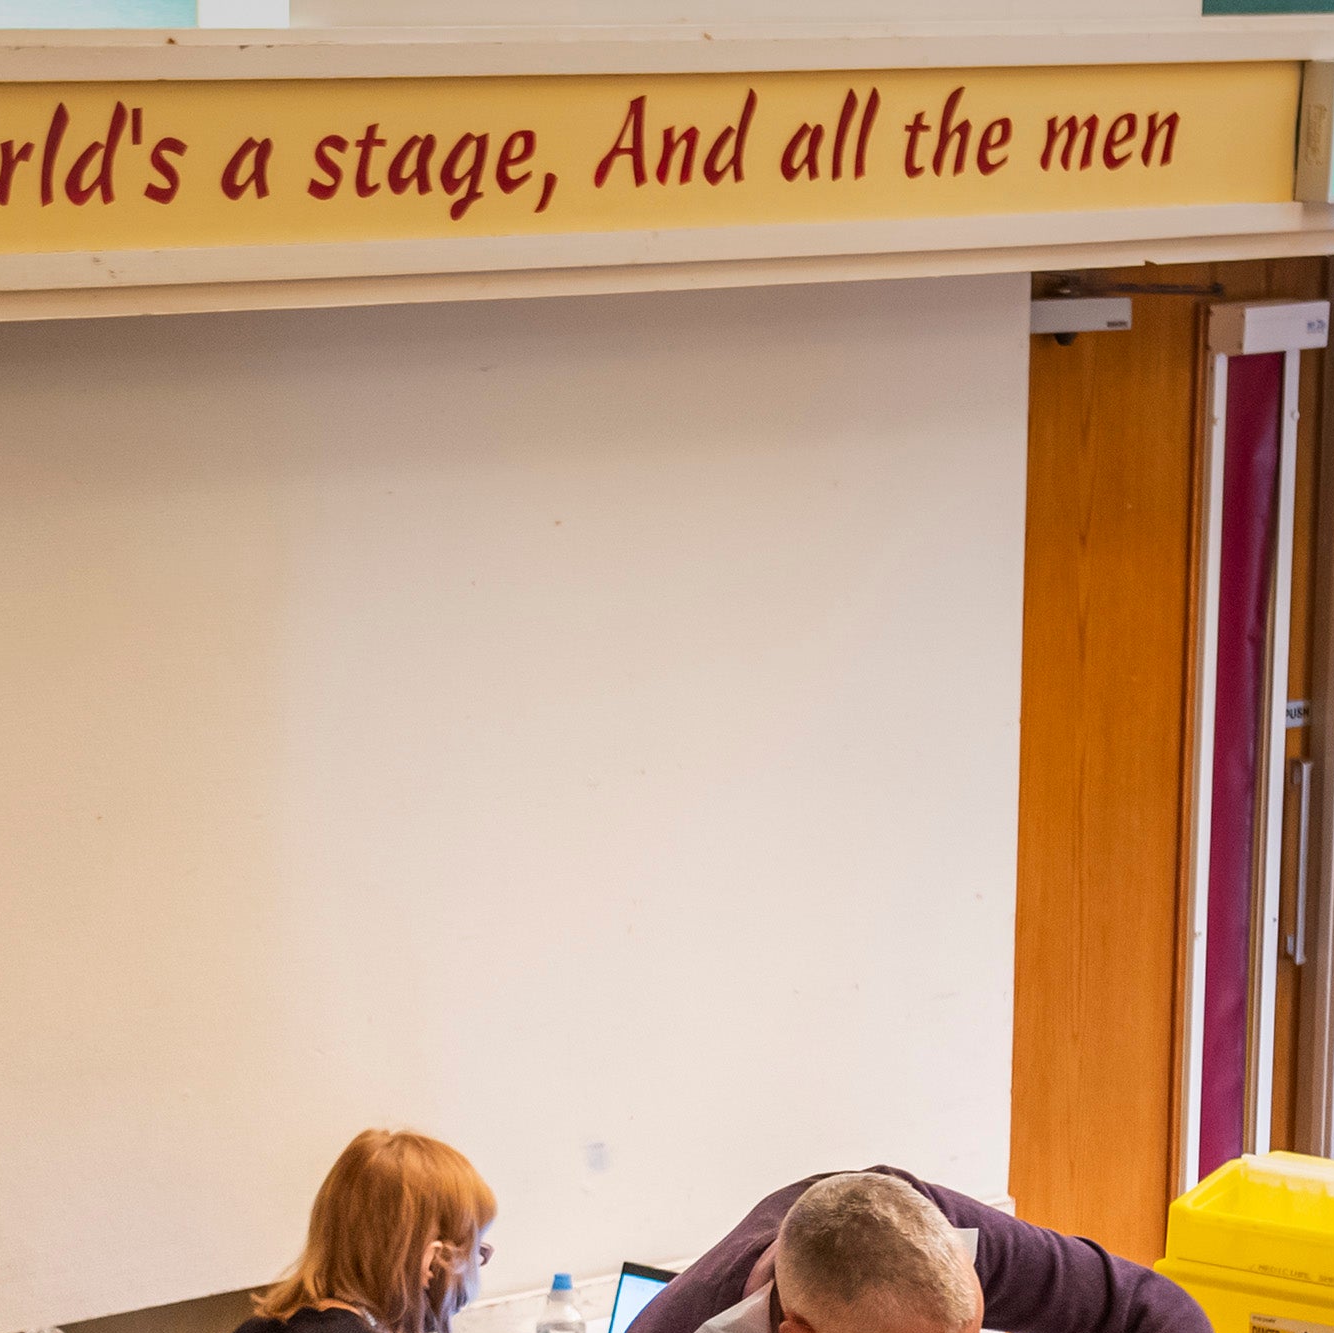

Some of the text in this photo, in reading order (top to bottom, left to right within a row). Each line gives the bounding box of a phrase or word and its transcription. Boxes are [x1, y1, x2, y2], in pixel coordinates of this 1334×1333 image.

[219, 136, 274, 201] a
[306, 122, 558, 222] stage,
[593, 88, 758, 189] And
[779, 86, 881, 183] all
[904, 86, 1013, 179] the
[1039, 111, 1181, 172] men
